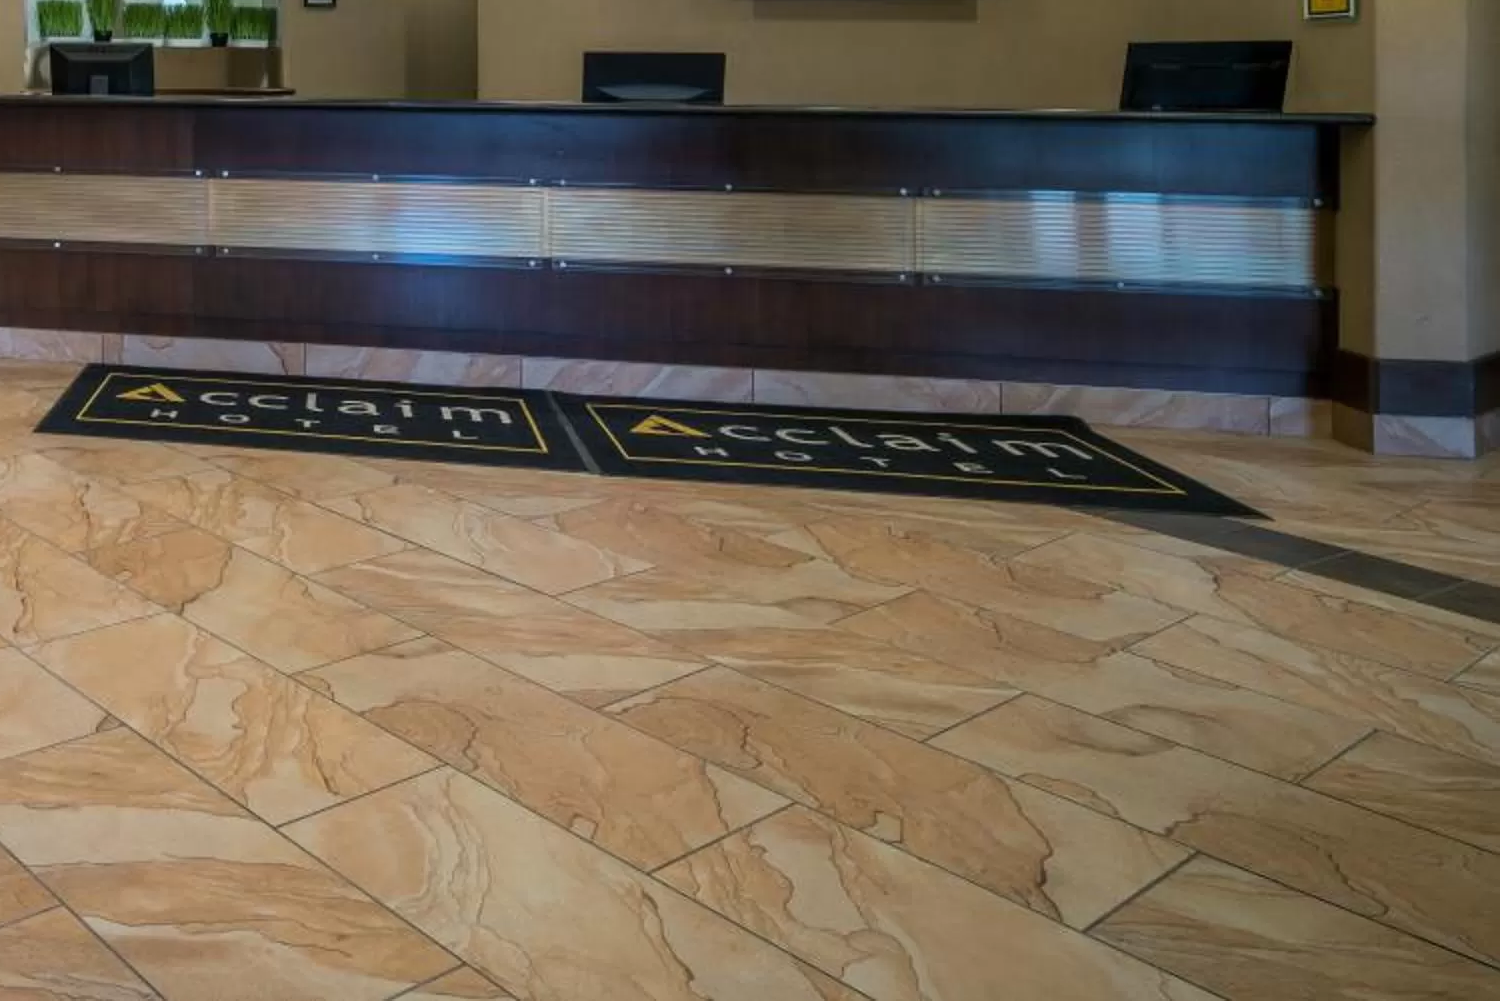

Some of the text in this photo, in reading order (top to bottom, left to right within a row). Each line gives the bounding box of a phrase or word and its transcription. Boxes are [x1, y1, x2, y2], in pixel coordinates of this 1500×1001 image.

[115, 382, 512, 425] Acclaim
[149, 407, 479, 440] HOTEL
[629, 414, 1093, 462] Acclaim
[693, 445, 1088, 481] HOTEL
